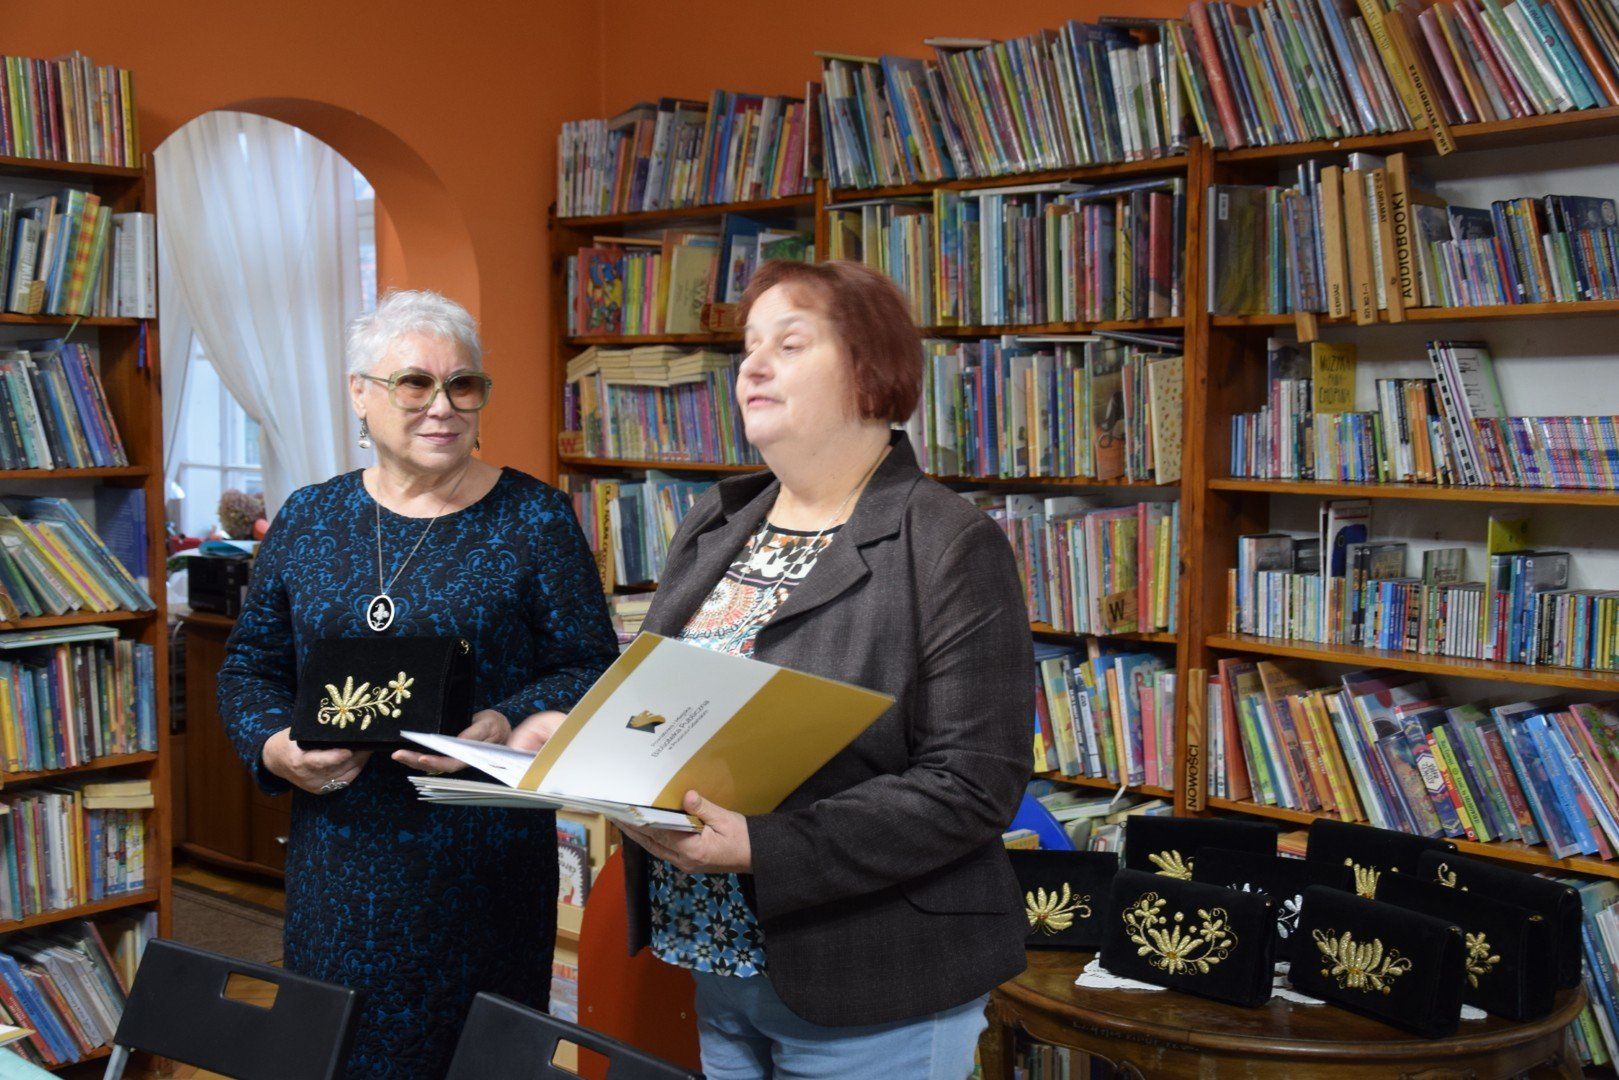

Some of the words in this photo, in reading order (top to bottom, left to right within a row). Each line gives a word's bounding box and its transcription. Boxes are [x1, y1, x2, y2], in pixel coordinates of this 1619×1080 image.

[1391, 191, 1413, 299] AUDIOBOOKI
[1109, 599, 1125, 623] W
[651, 728, 682, 757] Biblioteka
[679, 700, 710, 728] Publiczna
[1186, 744, 1199, 808] NOWOŚCI
